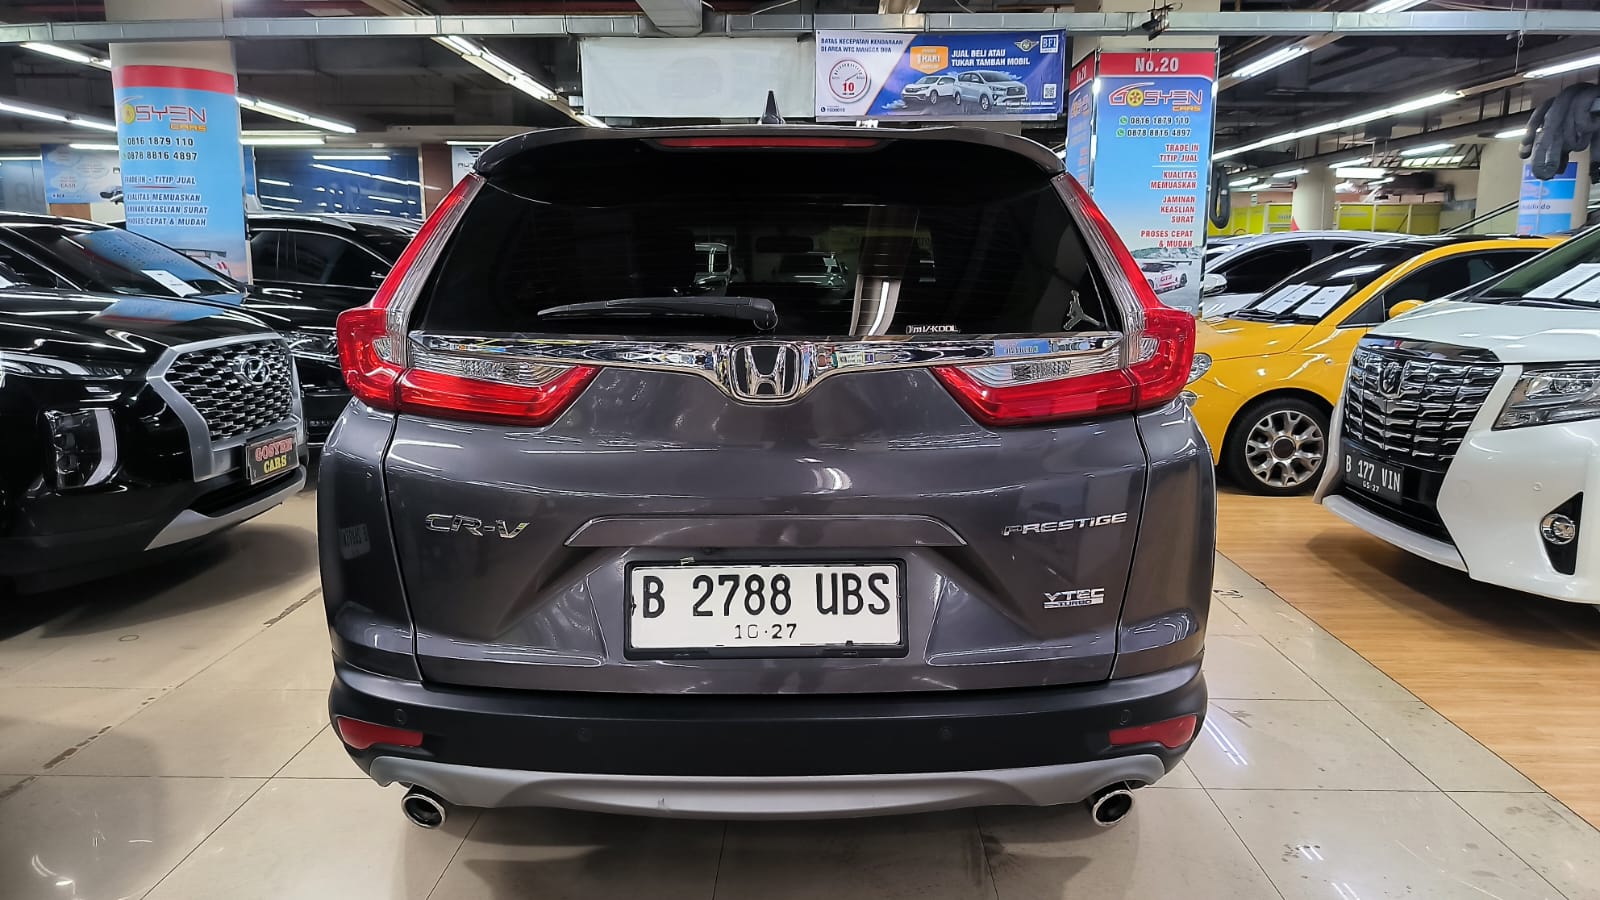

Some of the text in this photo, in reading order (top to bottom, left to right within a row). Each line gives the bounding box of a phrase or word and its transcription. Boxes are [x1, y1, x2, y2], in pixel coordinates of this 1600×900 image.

[1042, 37, 1056, 48] BFI
[951, 49, 1006, 58] JUAL BELI ATAU
[951, 57, 1030, 67] TUKAR TAMBAH MOBIL
[1135, 57, 1179, 72] No.20
[842, 82, 855, 92] 10
[1130, 117, 1190, 125] 0816 1879 110
[1127, 129, 1191, 137] 0878 8816 4897
[148, 137, 171, 146] 1879
[175, 138, 194, 146] 110
[1165, 144, 1189, 152] TRADE
[146, 152, 170, 160] 8816
[173, 152, 198, 160] 4897
[1160, 154, 1178, 162] TITIP
[1163, 171, 1197, 179] KUALITAS
[155, 176, 174, 184] TITIP
[176, 177, 196, 185] JUAL
[1150, 181, 1197, 189] MEMUASKAN
[152, 194, 201, 202] MEMUASKAN
[146, 205, 181, 213] KEASLIAN
[183, 206, 208, 214] SURAT
[146, 217, 167, 225] CEPAT
[178, 218, 206, 226] MUDAH
[1171, 215, 1194, 223] SURAT
[1158, 240, 1164, 248] &
[263, 455, 287, 474] CARS
[1345, 454, 1401, 493] B 177 VIN
[425, 513, 531, 539] CR-V
[1003, 512, 1128, 536] PRESTIGE
[642, 572, 891, 619] B 2788 UBS
[1044, 587, 1105, 602] VTEC
